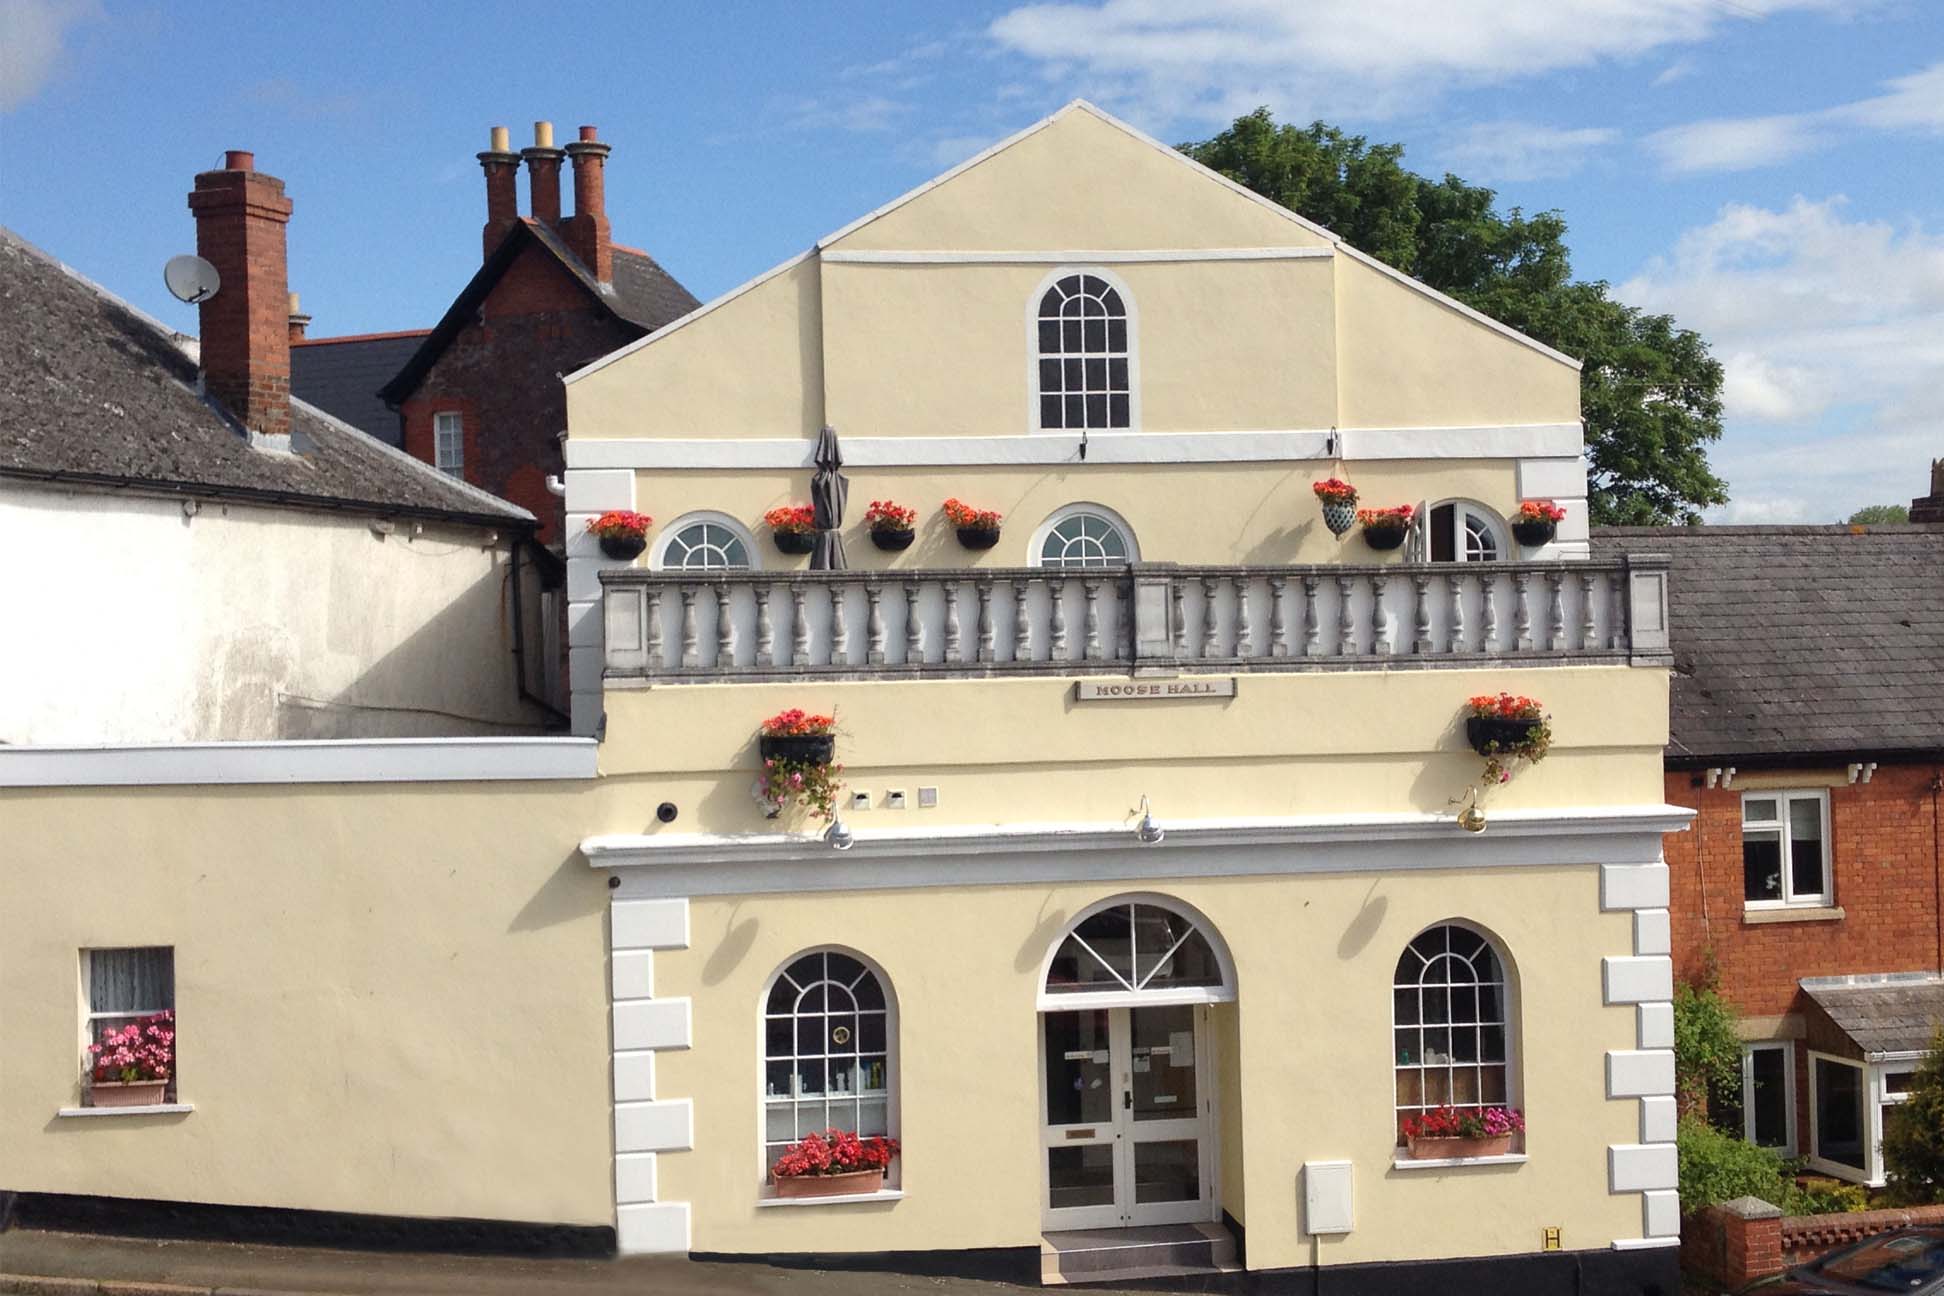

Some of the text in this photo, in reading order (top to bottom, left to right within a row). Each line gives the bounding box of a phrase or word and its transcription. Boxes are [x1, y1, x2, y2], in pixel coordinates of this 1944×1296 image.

[1096, 684, 1217, 696] MOOSE HALL
[1545, 1229, 1560, 1248] H
